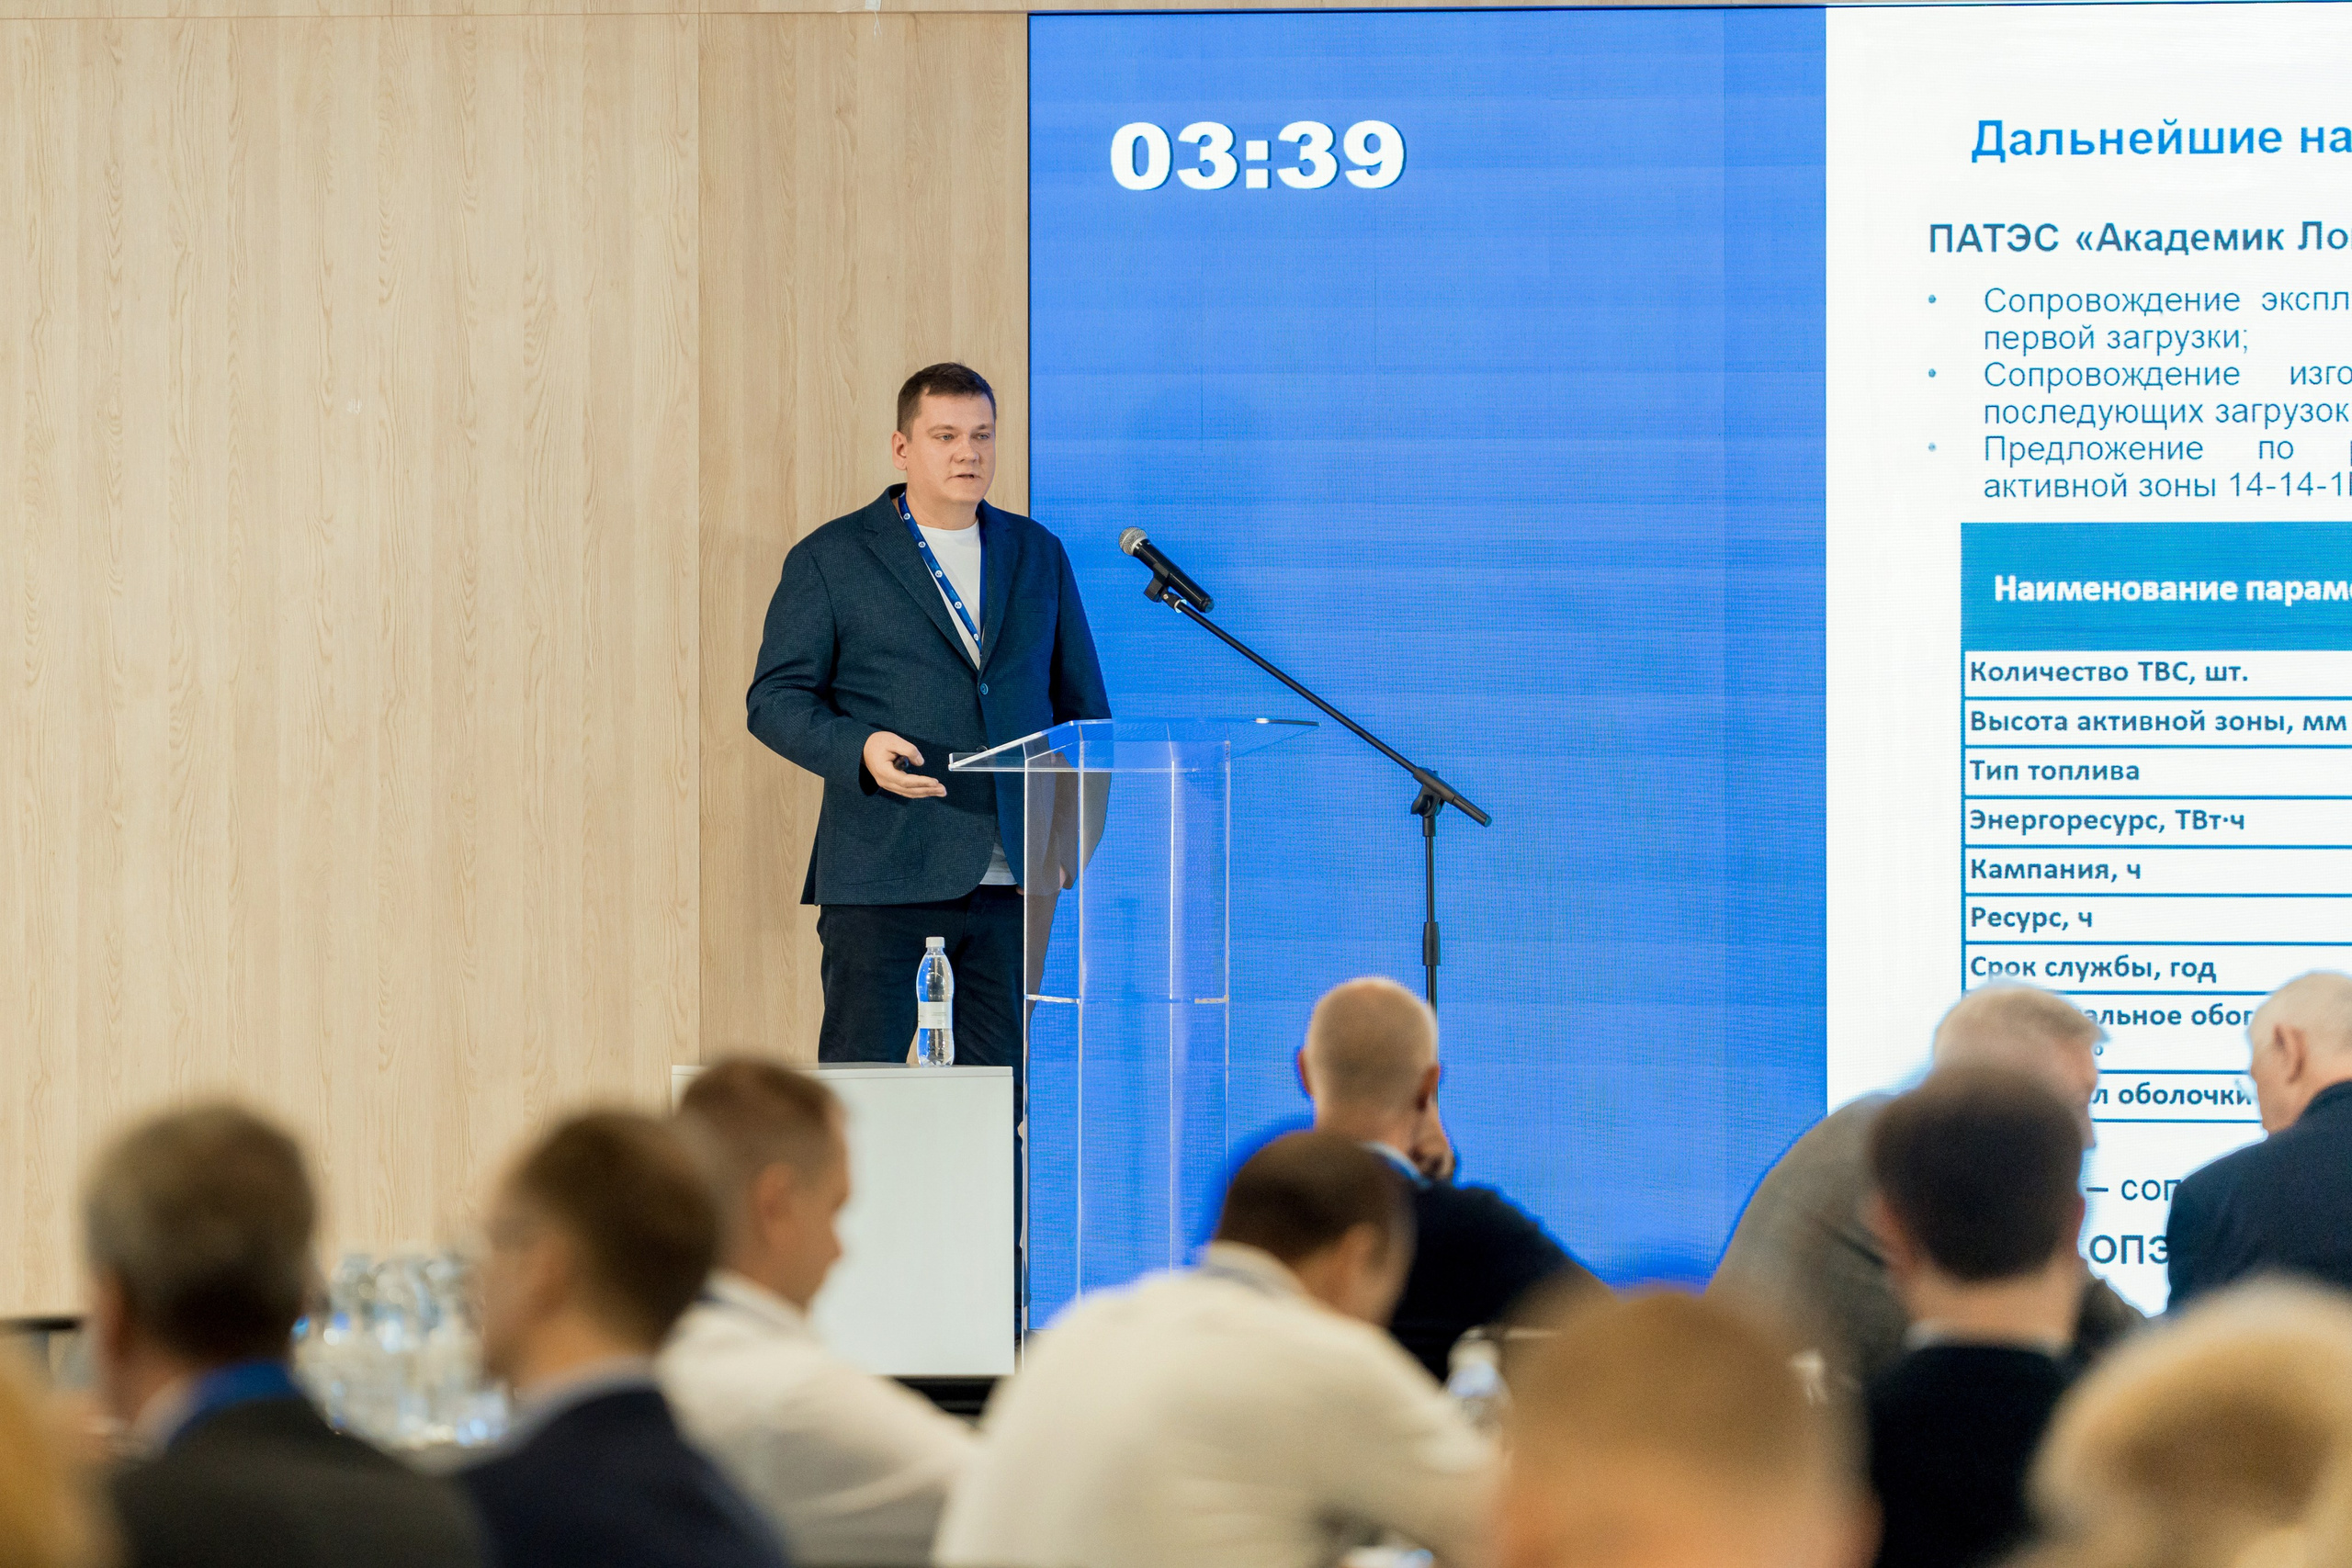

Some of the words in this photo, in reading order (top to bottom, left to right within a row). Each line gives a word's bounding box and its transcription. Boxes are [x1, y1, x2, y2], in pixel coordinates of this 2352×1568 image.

[1110, 119, 1405, 191] 03:39
[1971, 118, 2283, 164] Дальнейшие
[2301, 126, 2352, 153] на
[1929, 222, 2059, 254] ПАТЭС
[2075, 221, 2285, 256] «Академик
[2297, 220, 2352, 251] Ло
[1984, 287, 2241, 321] Сопровождение
[2261, 291, 2349, 311] экспл
[1984, 324, 2095, 357] первой
[2107, 329, 2248, 356] загрузки;
[1984, 361, 2241, 394] Сопровождение
[2290, 365, 2352, 386] изго
[1984, 403, 2204, 431] последующих
[2215, 402, 2349, 430] загрузок
[1984, 434, 2204, 468] Предложение
[2258, 440, 2294, 460] по
[1984, 472, 2127, 498] активной
[2139, 478, 2216, 498] зоны
[2230, 470, 2352, 497] 14-14-1
[1995, 574, 2239, 602] Наименование
[2245, 580, 2352, 607] парам
[1971, 660, 2130, 682] Количество
[2137, 660, 2196, 685] ТВС,
[2205, 665, 2248, 682] шт.
[1971, 710, 2068, 731] Высота
[2077, 709, 2206, 731] активной
[2214, 715, 2294, 735] зоны,
[2302, 715, 2347, 731] мм
[1969, 759, 2019, 781] Тип
[2027, 764, 2140, 781] топлива
[1970, 808, 2165, 837] Энергоресурс,
[1971, 858, 2118, 883] Кампания,
[2126, 863, 2142, 880] ч
[1971, 906, 2069, 934] Ресурс,
[2077, 911, 2093, 928] ч
[1971, 956, 2036, 983] Срок
[2044, 953, 2161, 984] службы,
[2170, 961, 2217, 984] год
